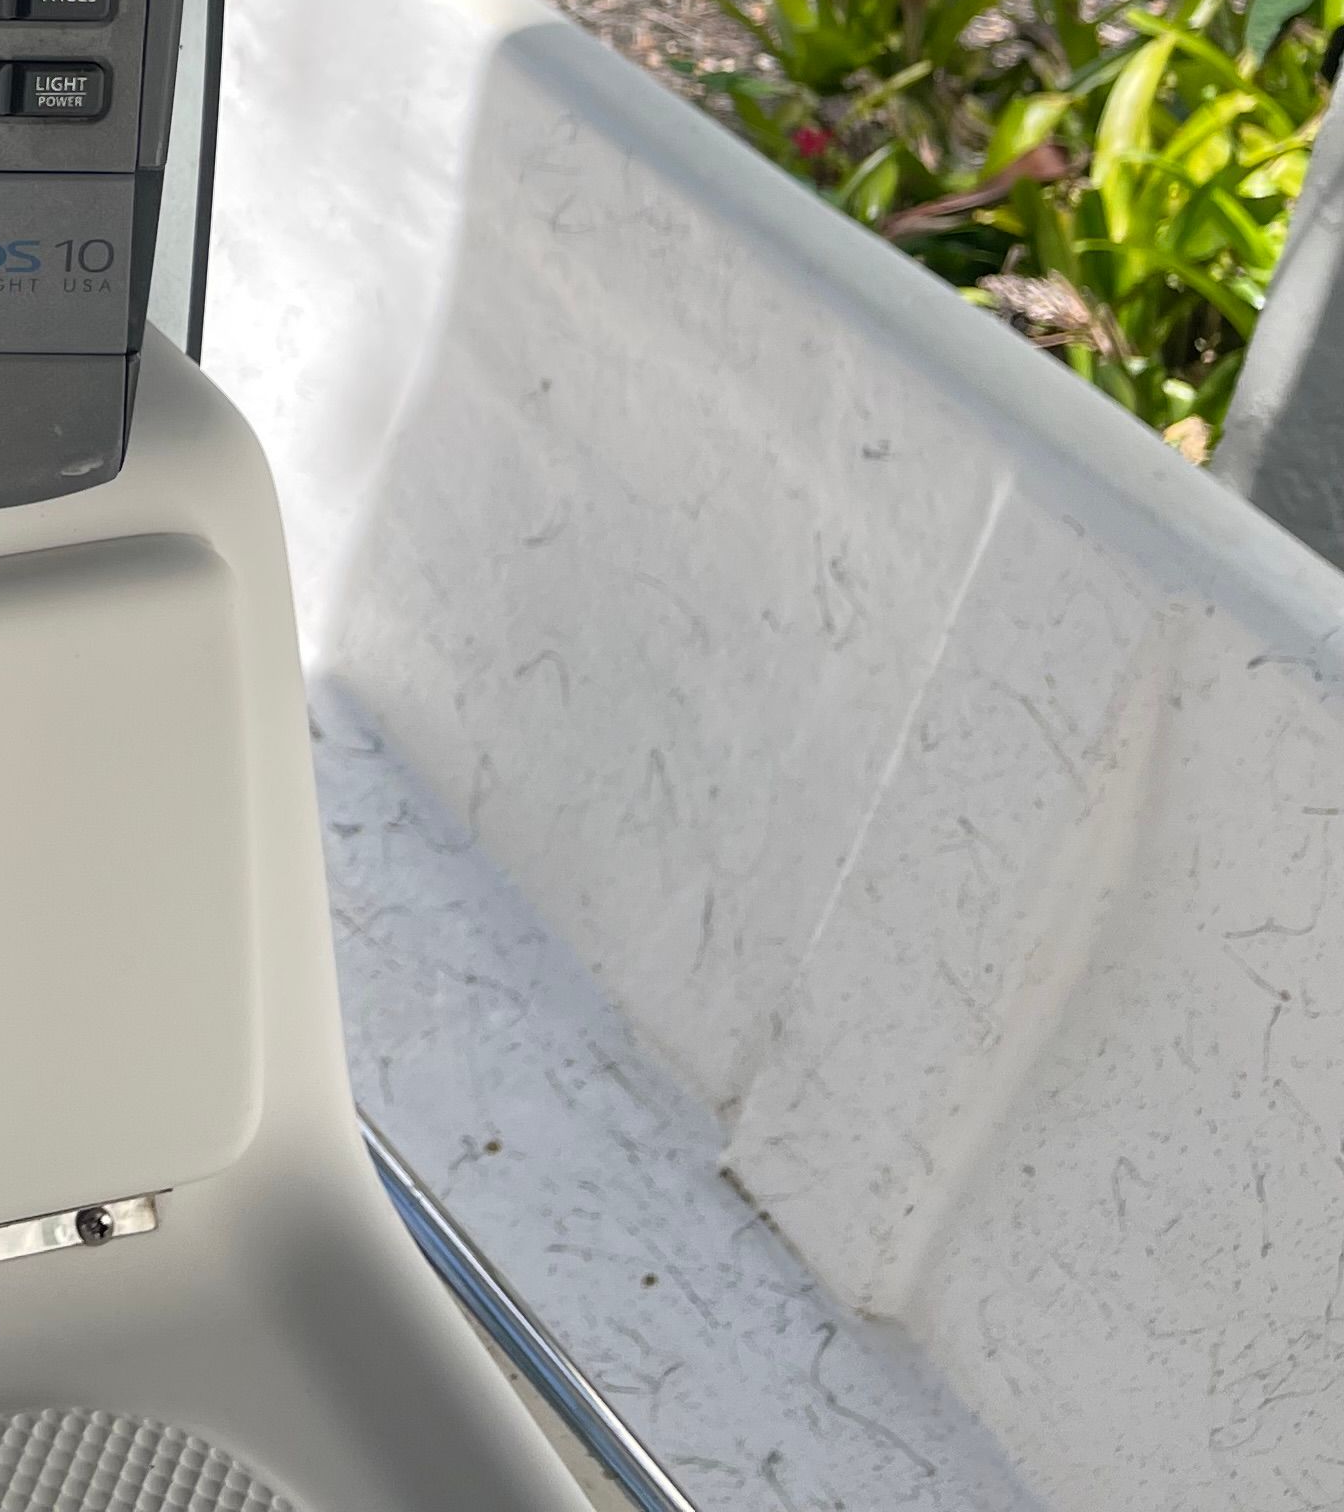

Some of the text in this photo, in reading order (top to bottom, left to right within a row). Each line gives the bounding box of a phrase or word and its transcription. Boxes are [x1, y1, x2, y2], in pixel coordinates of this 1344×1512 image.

[35, 76, 87, 91] LIGHT
[38, 96, 83, 107] POWER
[54, 239, 114, 273] 10
[64, 279, 112, 293] USA
